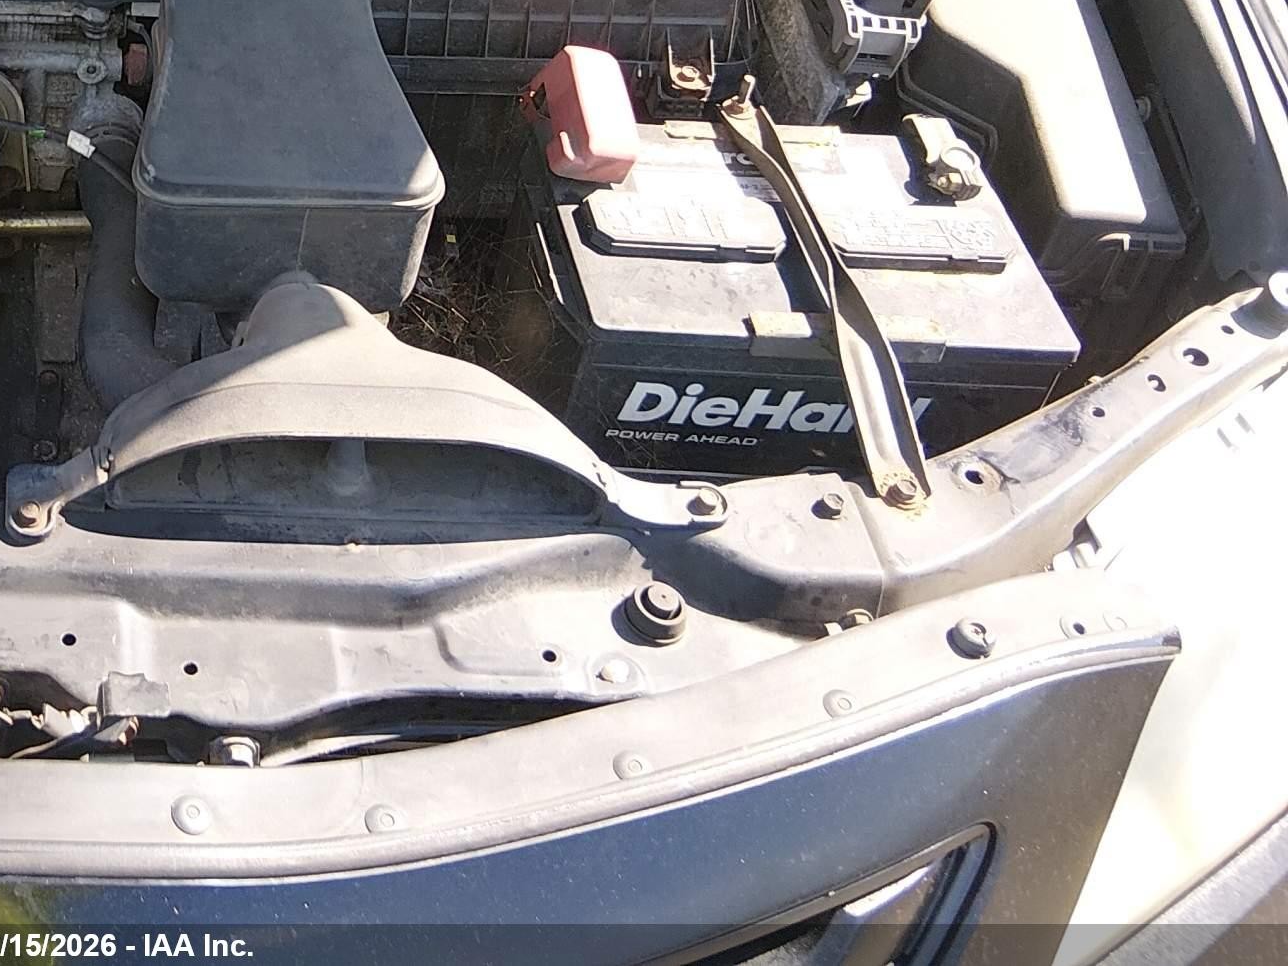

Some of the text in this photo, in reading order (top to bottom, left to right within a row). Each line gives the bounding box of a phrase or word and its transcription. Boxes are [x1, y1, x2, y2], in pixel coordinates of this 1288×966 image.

[617, 381, 933, 433] DieHar
[605, 429, 759, 446] POWER AHEAD
